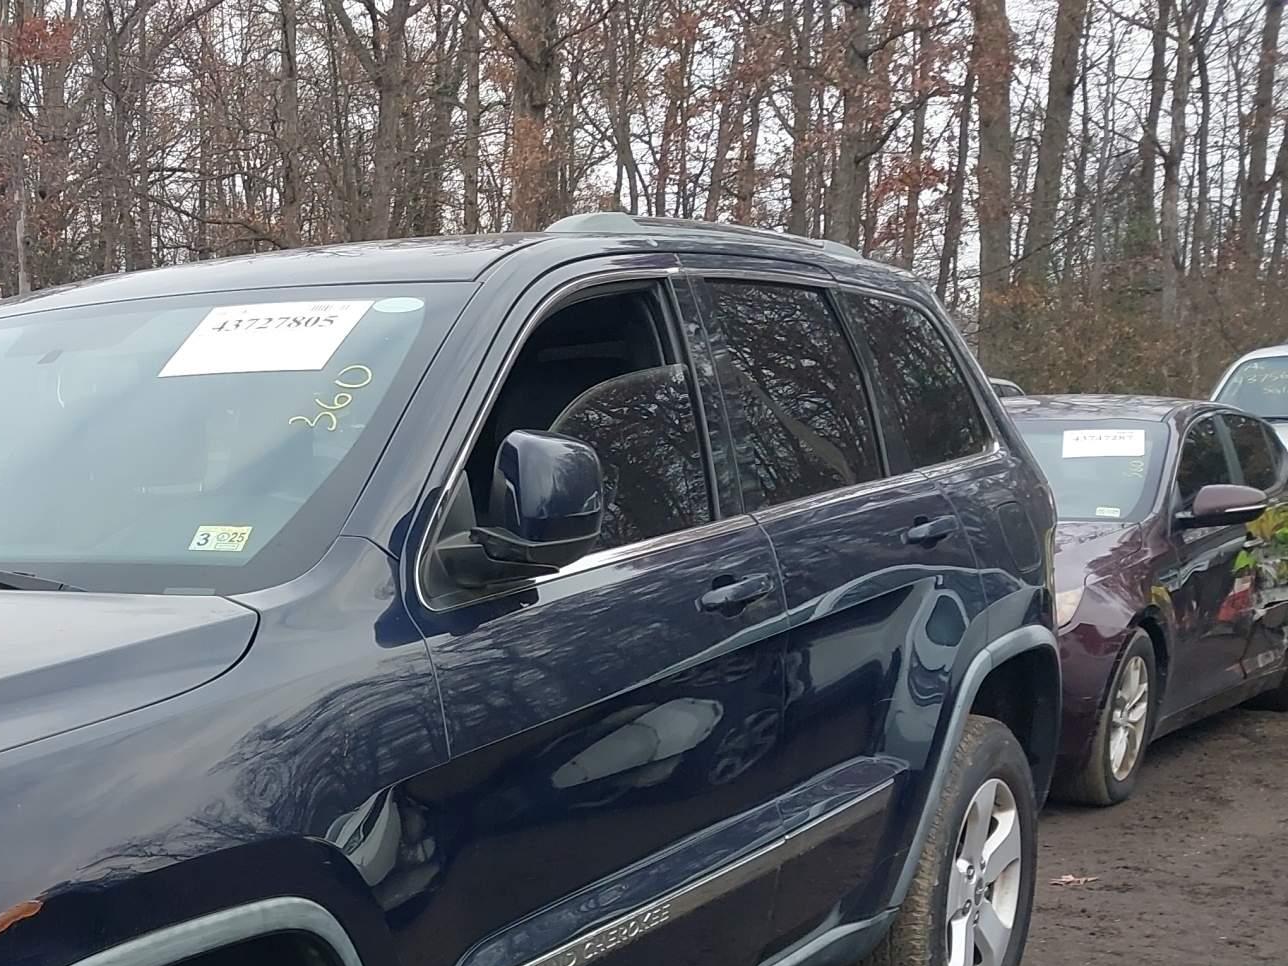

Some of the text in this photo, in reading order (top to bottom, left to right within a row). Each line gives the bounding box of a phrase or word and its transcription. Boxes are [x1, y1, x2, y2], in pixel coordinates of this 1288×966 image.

[212, 314, 339, 332] 43727805
[288, 364, 373, 431] 360
[196, 532, 247, 546] 3 25
[583, 903, 672, 961] CHEROKEE
